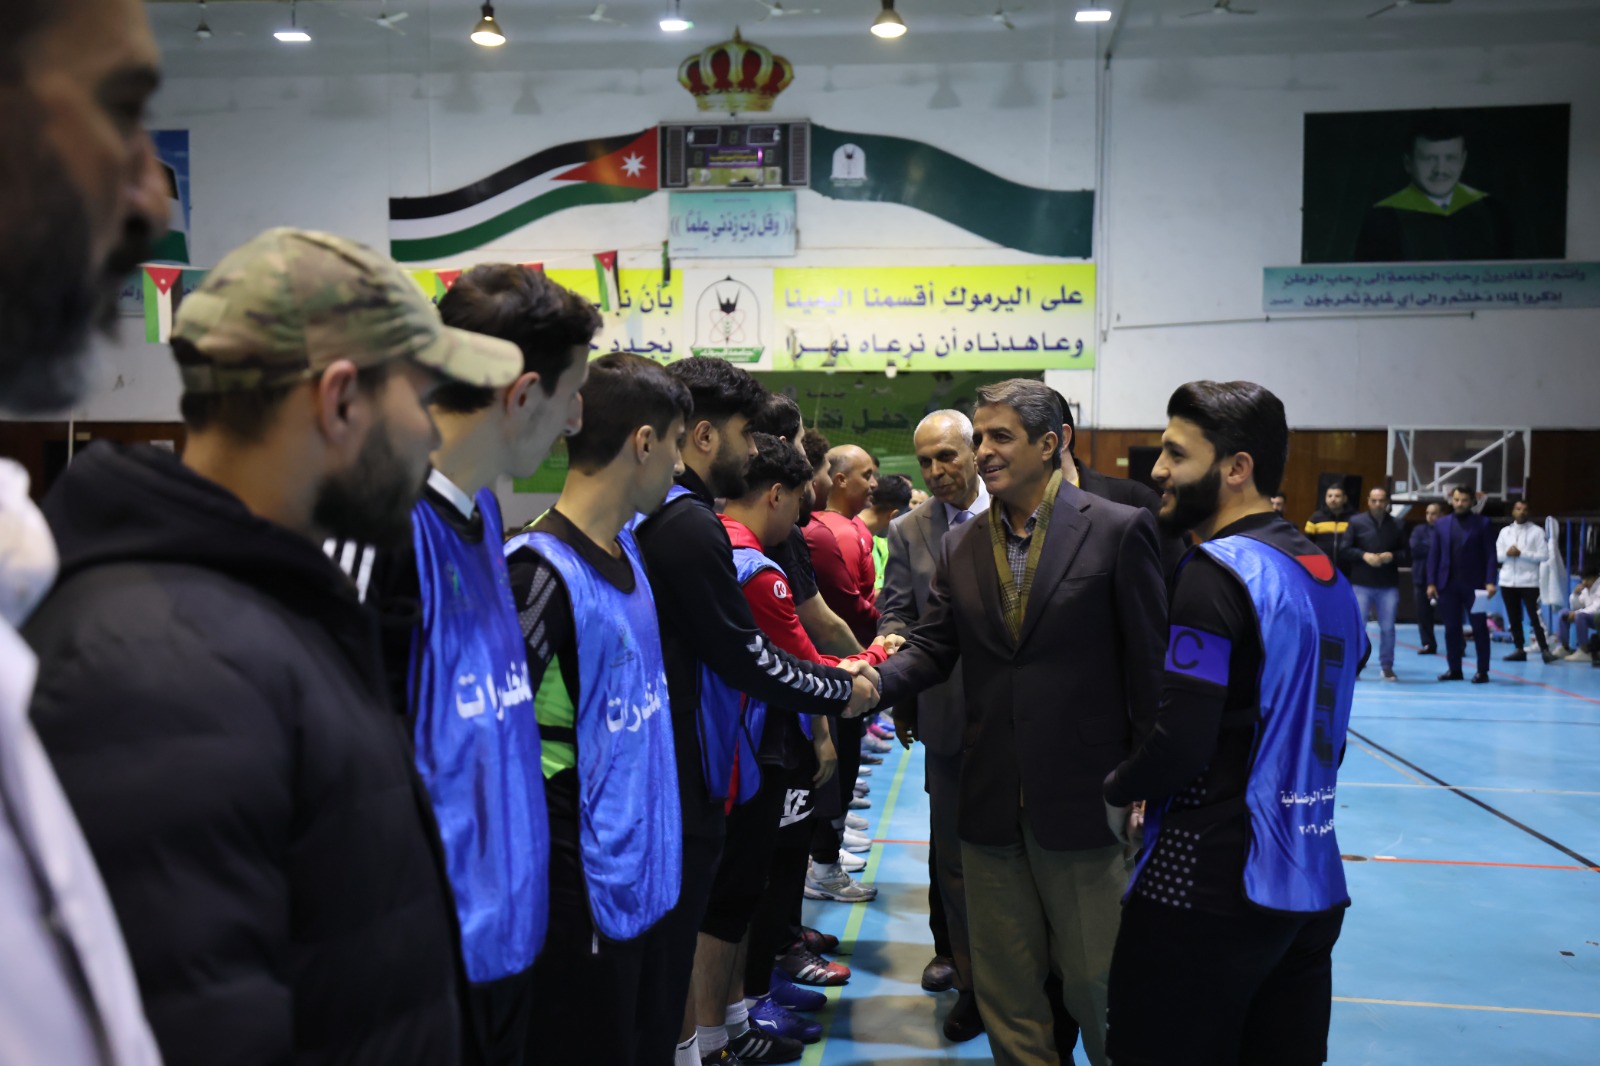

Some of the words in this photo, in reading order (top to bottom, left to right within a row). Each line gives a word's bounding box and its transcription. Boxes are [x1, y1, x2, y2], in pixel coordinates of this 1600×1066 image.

[785, 287, 852, 314] اليمينا
[864, 281, 934, 308] أقسمنا
[943, 285, 1031, 312] اليرموك
[1041, 284, 1083, 311] على
[859, 333, 925, 358] نرعاه
[934, 326, 957, 357] أن
[963, 331, 1083, 358] وعاهدناه
[1171, 630, 1204, 670] C
